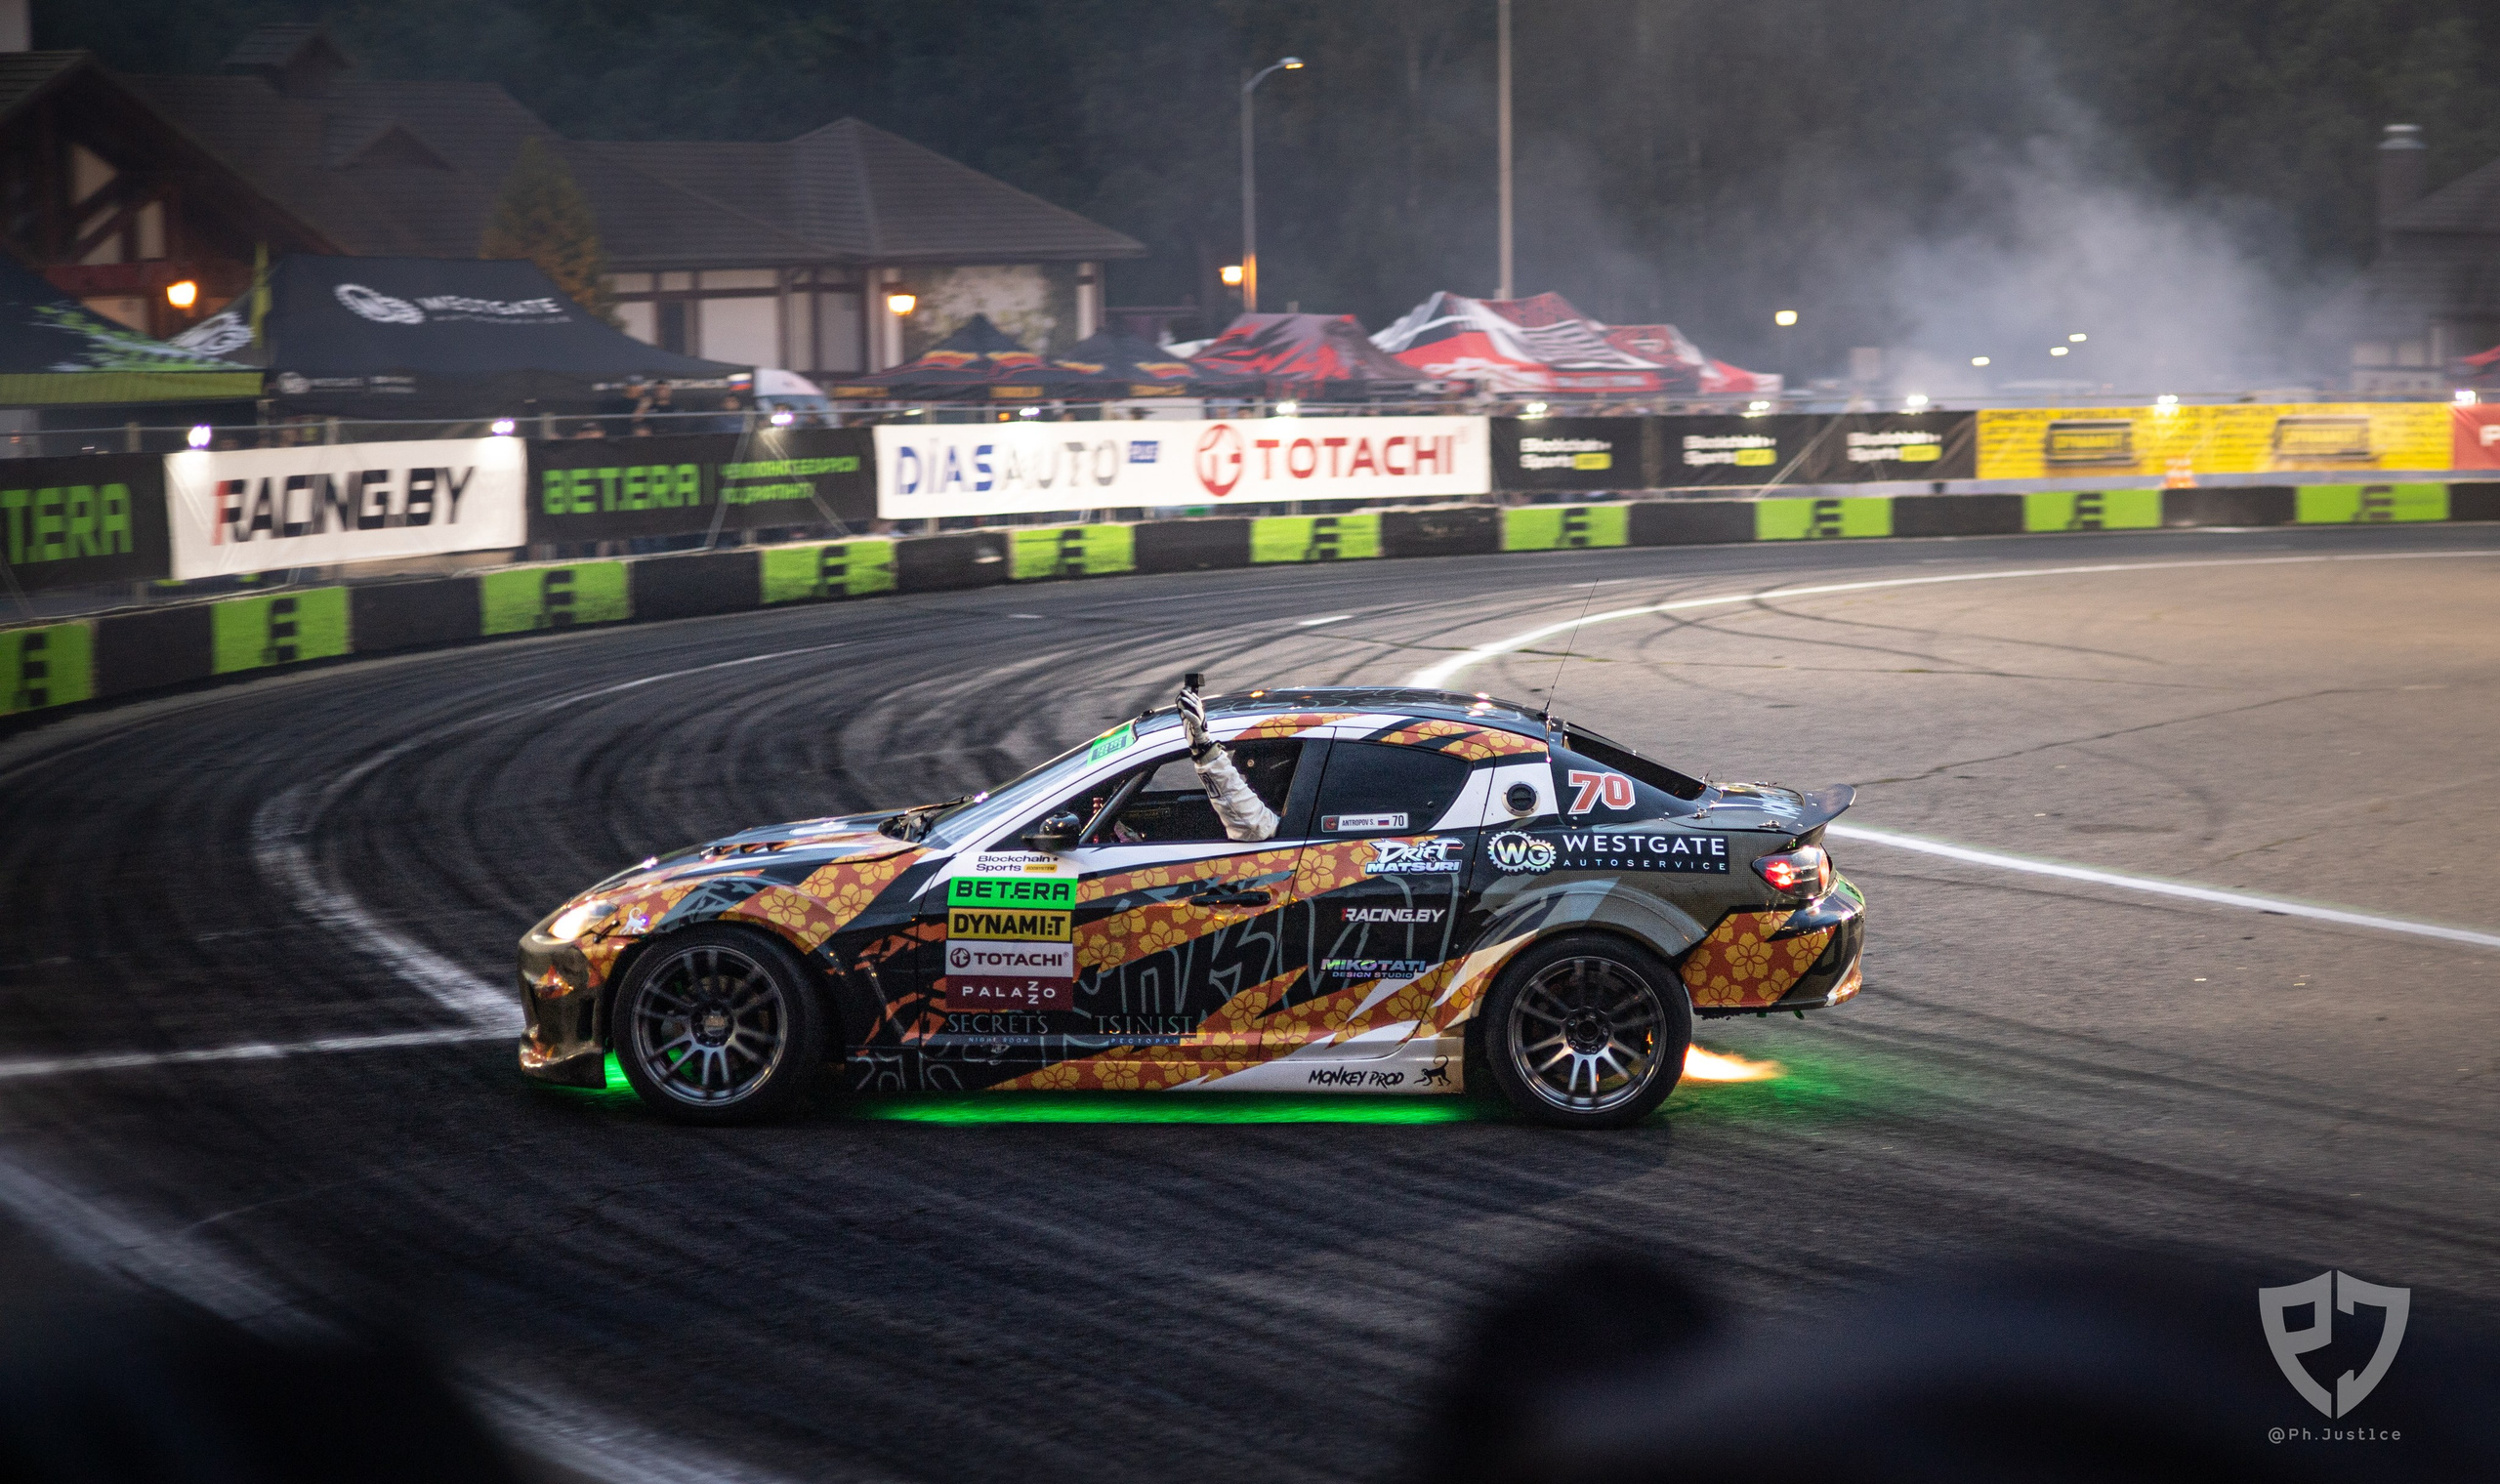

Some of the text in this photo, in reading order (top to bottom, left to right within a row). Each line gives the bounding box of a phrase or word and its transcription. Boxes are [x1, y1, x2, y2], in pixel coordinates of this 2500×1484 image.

[1255, 435, 1455, 479] TOTACHI
[1567, 769, 1637, 814] 70
[1392, 815, 1404, 826] 70
[1562, 835, 1726, 856] WESTGATE
[976, 863, 1022, 873] Sports
[1367, 861, 1460, 873] MATSURI
[1563, 859, 1727, 871] AUTOSERVICE
[1342, 908, 1445, 923] RACING.BY
[974, 952, 1062, 967] TOTACHI
[1320, 959, 1426, 972] MIKOTATI
[1095, 1015, 1192, 1035] TSINIST
[1309, 1066, 1404, 1089] MONKEY PROD
